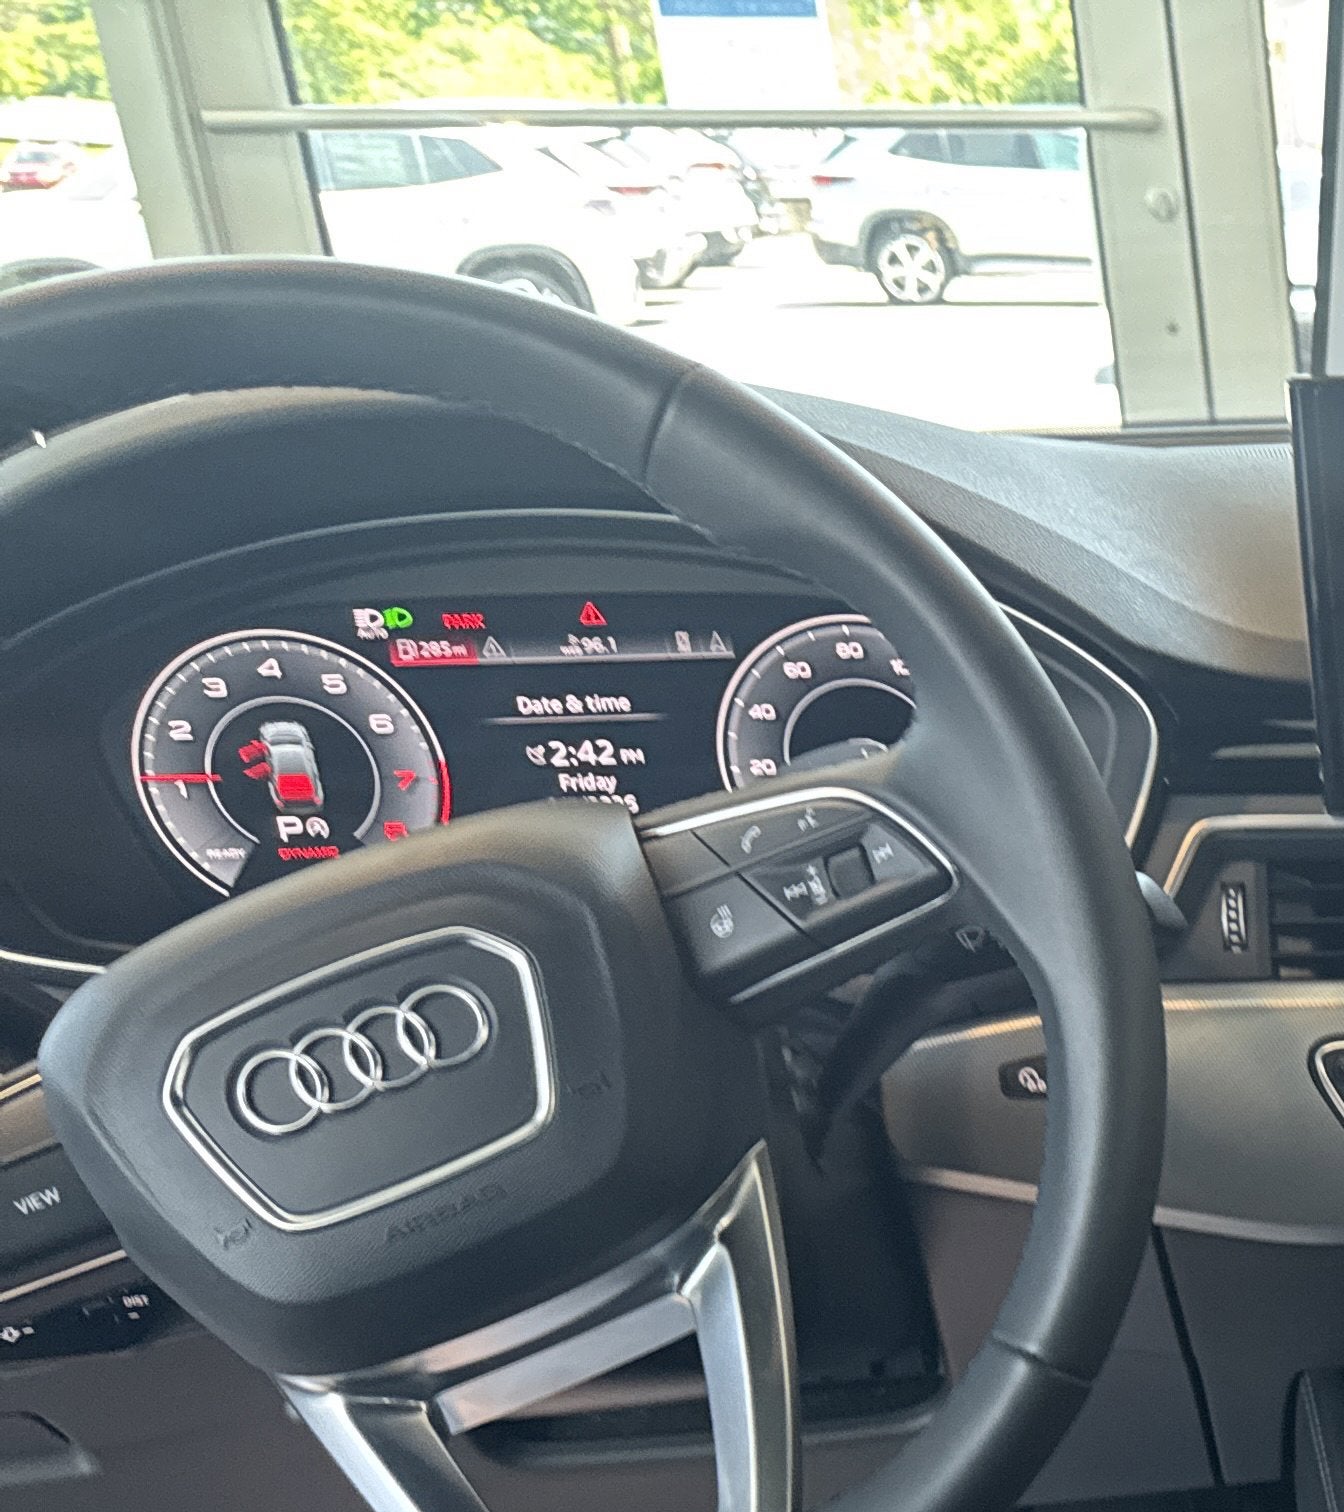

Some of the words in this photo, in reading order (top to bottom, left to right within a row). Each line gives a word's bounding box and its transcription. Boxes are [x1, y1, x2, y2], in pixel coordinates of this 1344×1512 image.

[835, 641, 864, 660] 80
[256, 657, 283, 680] 4
[782, 660, 812, 679] 60
[201, 676, 229, 699] 3
[320, 673, 348, 695] 5
[516, 694, 562, 715] Date
[564, 694, 585, 714] &
[585, 693, 633, 713] time
[748, 702, 777, 721] 40
[168, 719, 194, 742] 2
[368, 713, 395, 735] 6
[547, 737, 616, 767] 2:42
[749, 758, 778, 777] 20
[393, 769, 417, 791] 7
[558, 773, 619, 796] Friday
[276, 816, 304, 843] P
[12, 1186, 62, 1216] VIEW
